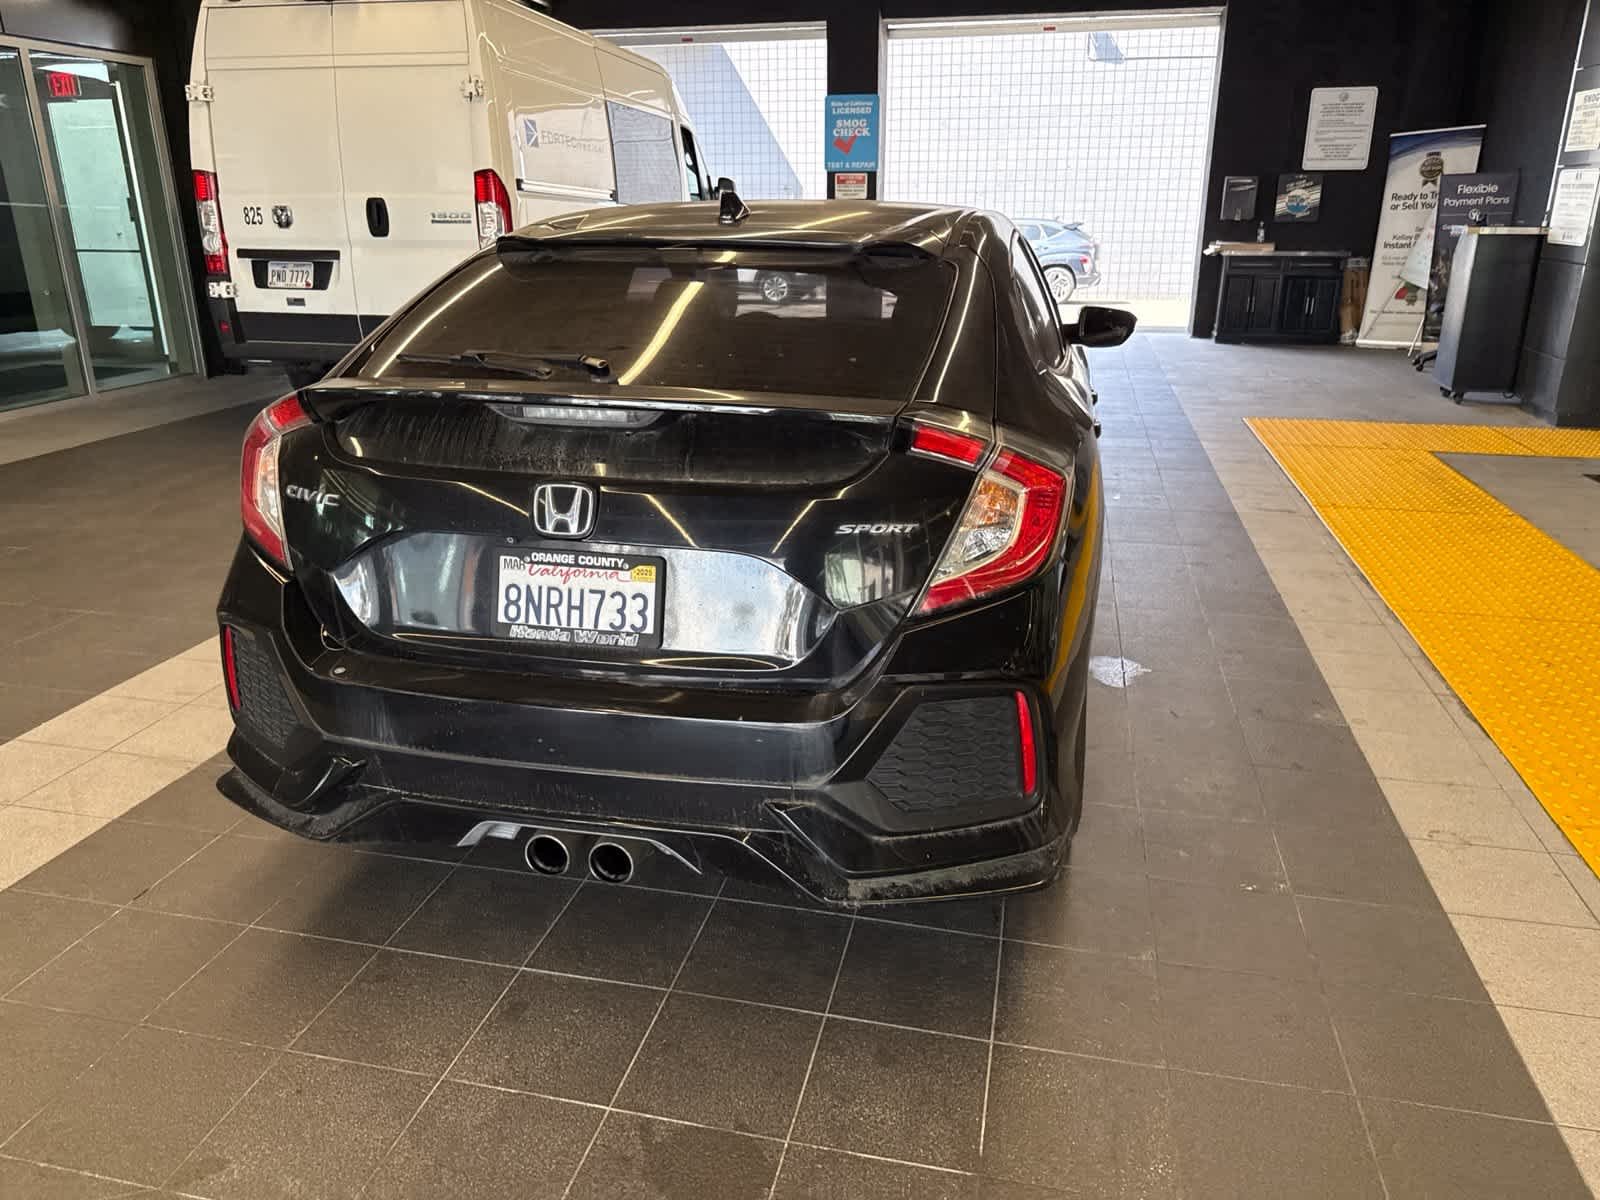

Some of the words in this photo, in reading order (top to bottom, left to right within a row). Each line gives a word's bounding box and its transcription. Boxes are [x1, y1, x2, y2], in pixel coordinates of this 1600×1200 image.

[51, 73, 77, 97] EXIT
[832, 107, 872, 115] LICENSED
[835, 119, 867, 128] SMOG
[832, 127, 871, 137] CHECK
[1457, 184, 1499, 194] Flexible
[1391, 192, 1418, 201] Ready
[1443, 197, 1484, 207] Payment
[1486, 196, 1511, 205] Plans
[1401, 202, 1418, 210] Sell
[243, 206, 264, 224] 825
[1383, 240, 1412, 249] Instant
[834, 523, 920, 535] SPORT
[503, 558, 526, 570] MAR
[531, 552, 575, 564] ORANGE
[578, 555, 624, 568] COUNTY
[528, 563, 628, 584] California
[504, 583, 649, 632] 8NRH733
[509, 625, 571, 642] Honda
[574, 630, 640, 647] World
